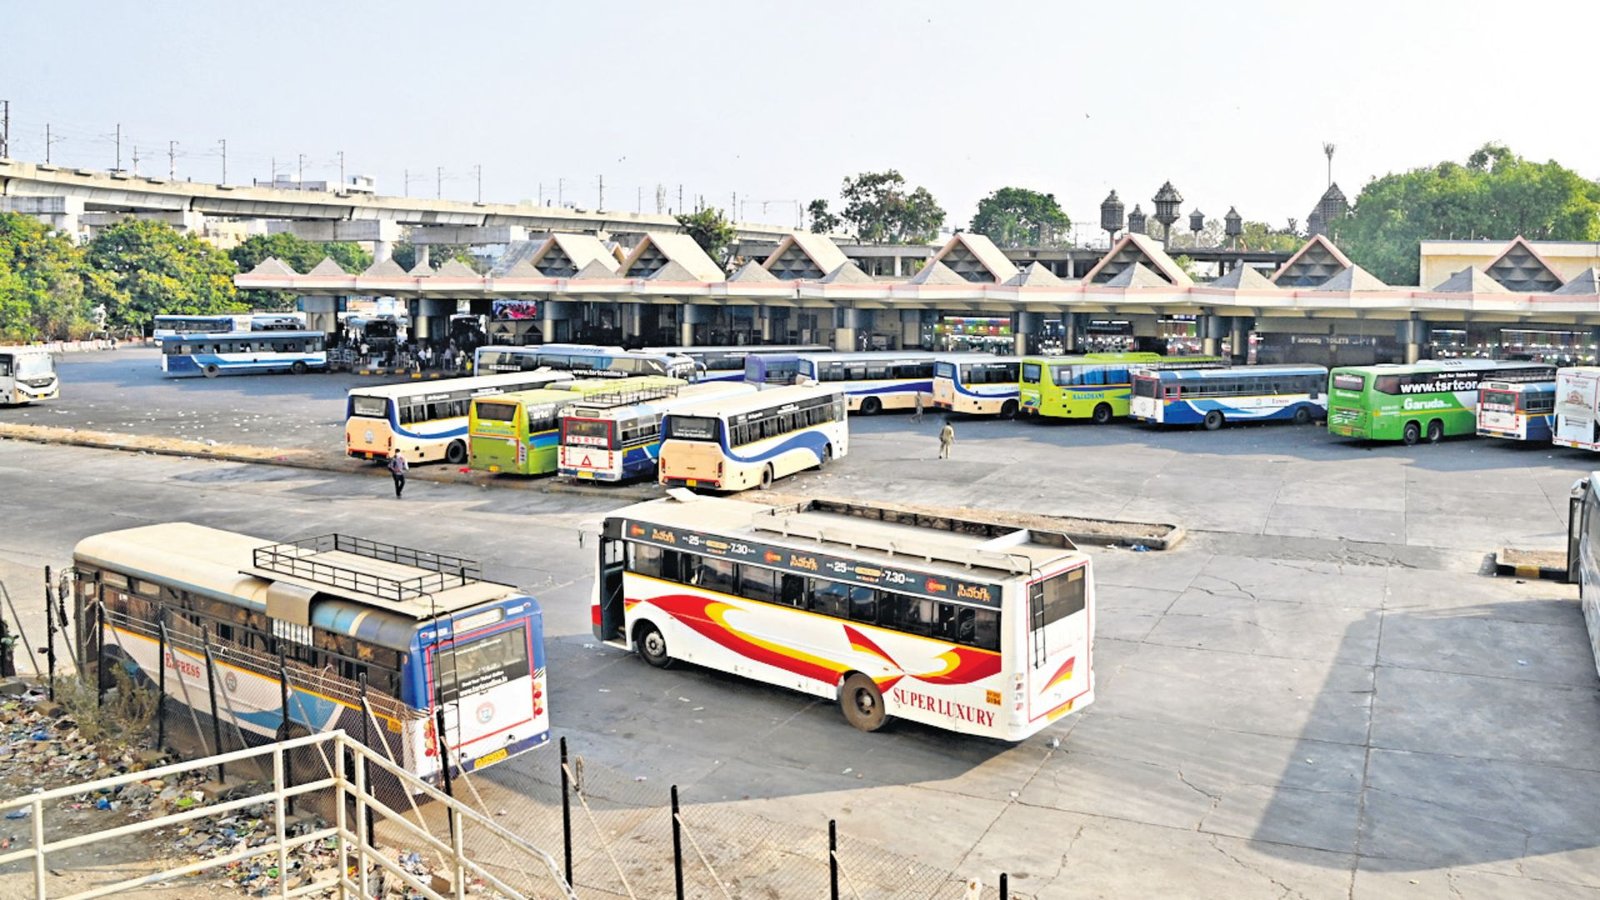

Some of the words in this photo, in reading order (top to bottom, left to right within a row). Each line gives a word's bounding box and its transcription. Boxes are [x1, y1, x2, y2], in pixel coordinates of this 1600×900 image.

[1404, 398, 1445, 410] Garuda
[689, 534, 700, 546] 25
[834, 561, 847, 573] 25
[884, 570, 906, 584] 7.30
[893, 687, 936, 713] SUPER
[938, 699, 995, 728] LUXURY
